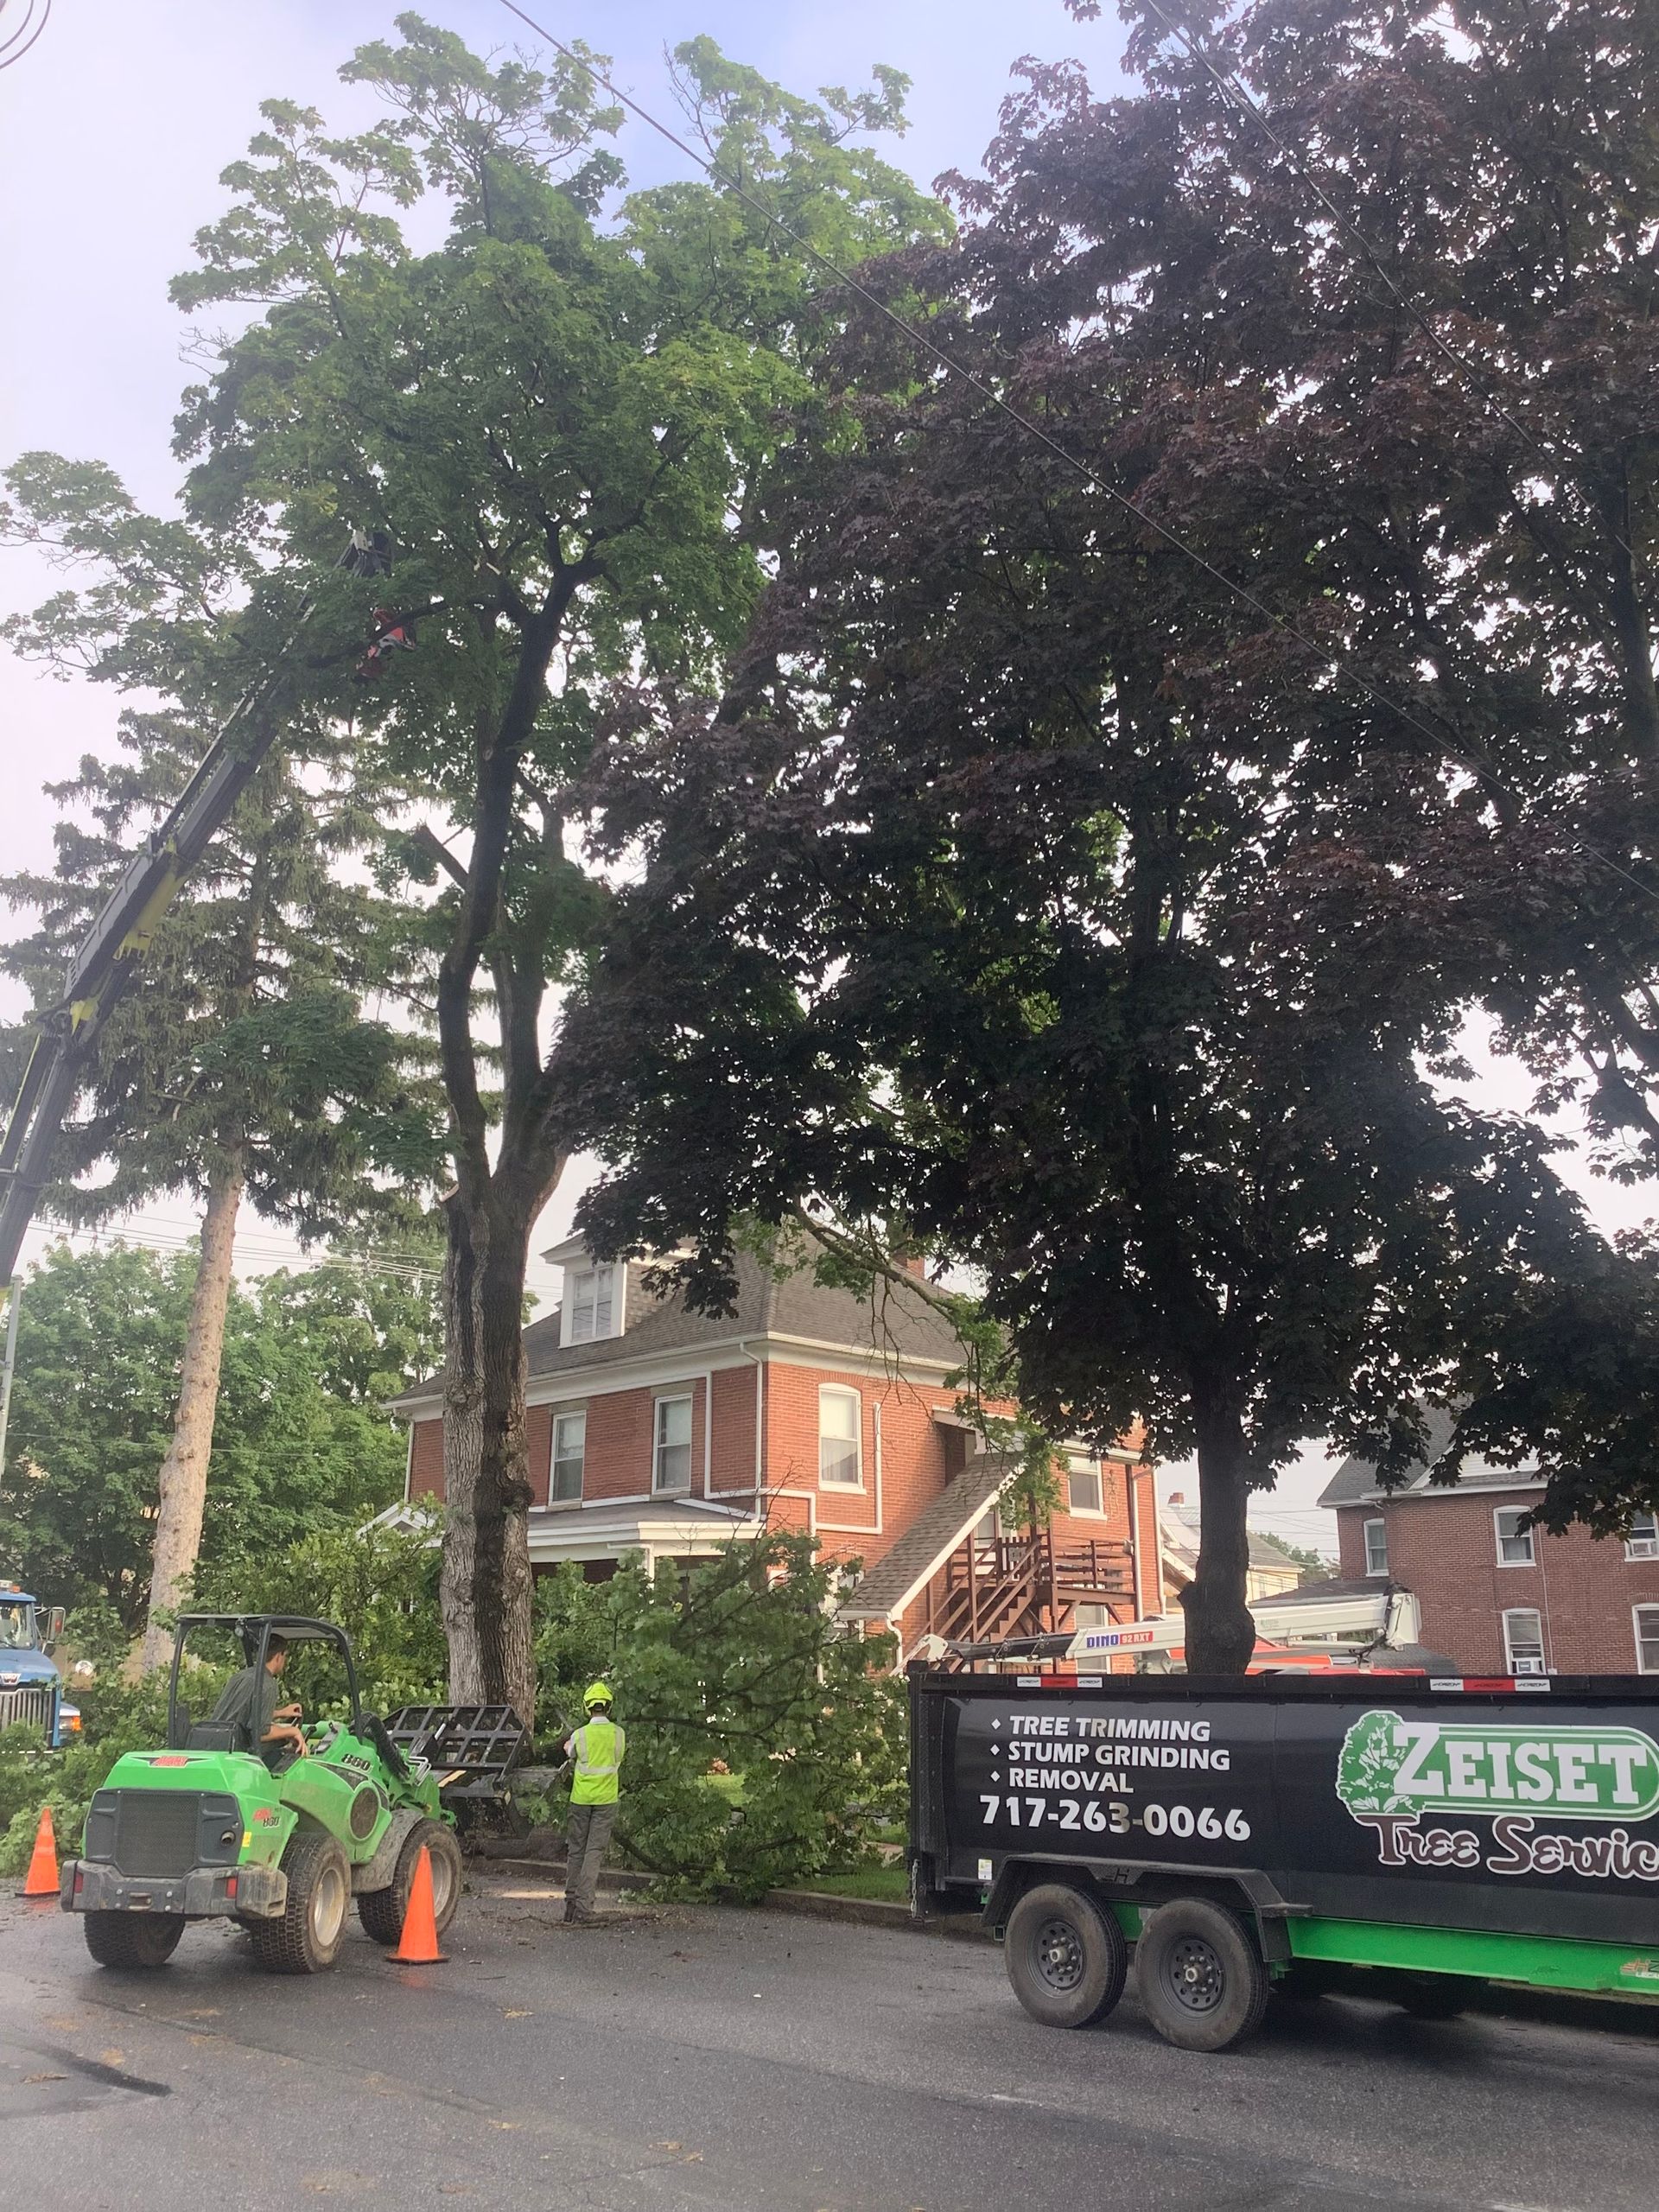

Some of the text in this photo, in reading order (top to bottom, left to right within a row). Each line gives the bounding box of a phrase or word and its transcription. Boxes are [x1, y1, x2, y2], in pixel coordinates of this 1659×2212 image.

[1086, 1635, 1119, 1648] DINO
[1009, 1716, 1211, 1742] TREE TRIMMING
[1008, 1741, 1230, 1770] STUMP GRINDING
[1393, 1722, 1648, 1805] ZEISET
[1009, 1768, 1134, 1793] REMOVAL
[980, 1796, 1251, 1841] 717-263-0066
[1357, 1815, 1659, 1880] Tree Servic
